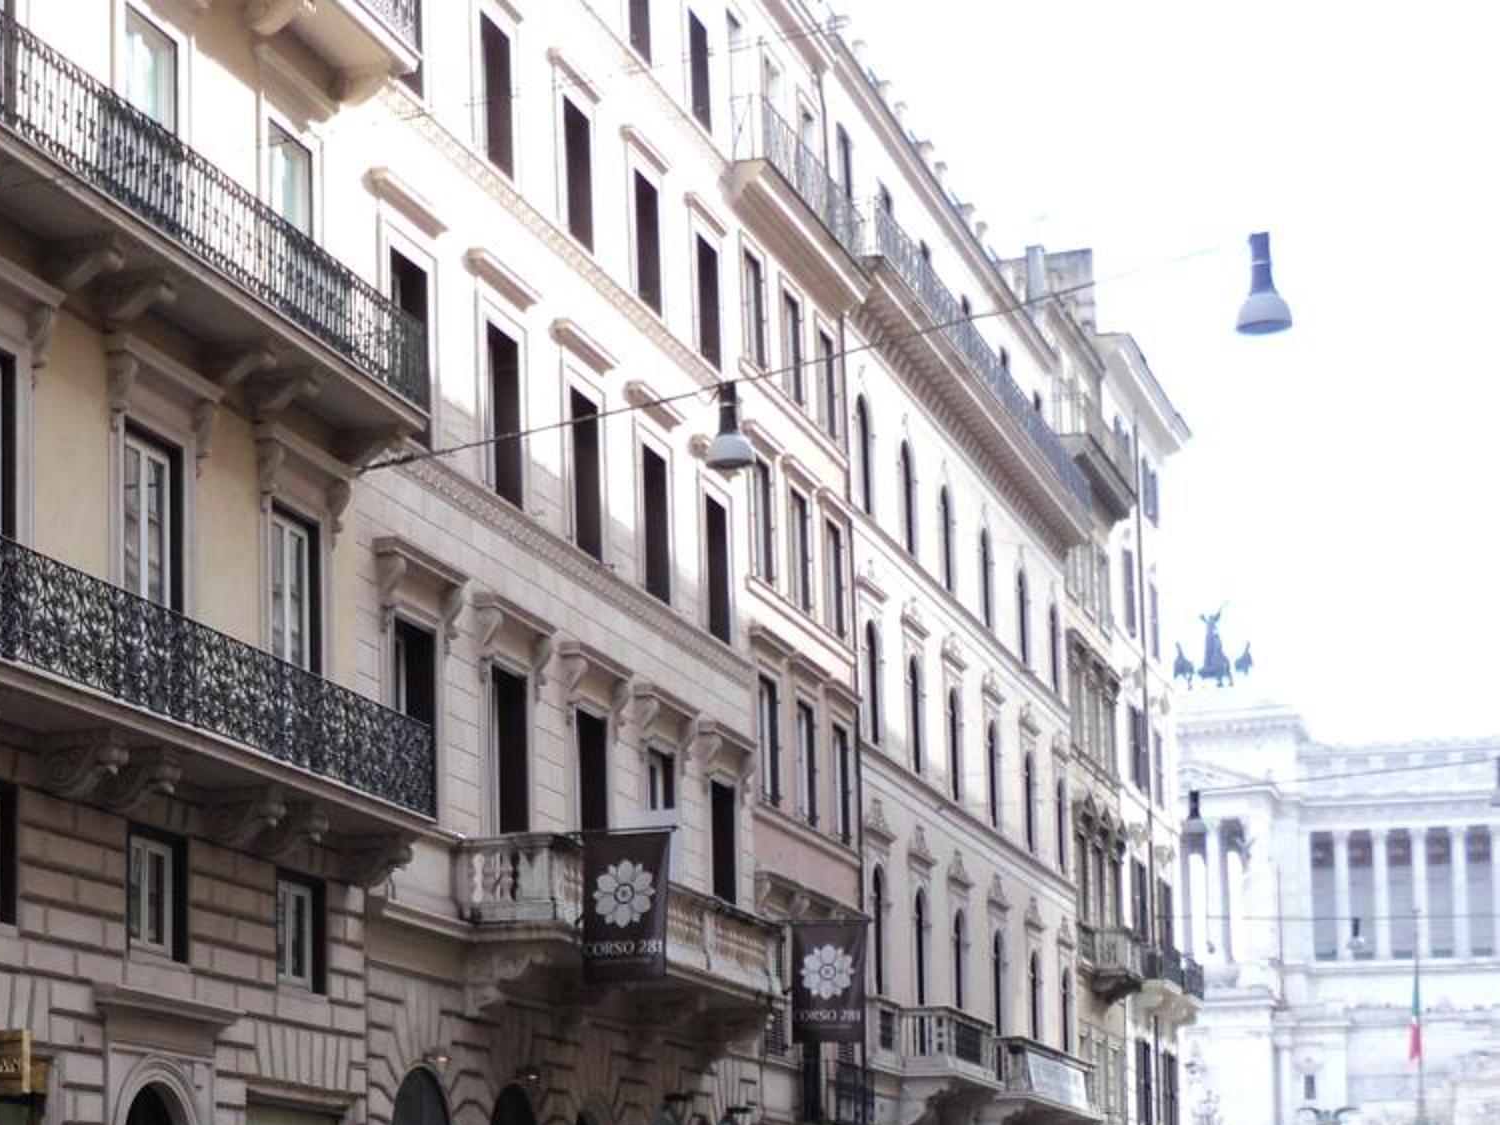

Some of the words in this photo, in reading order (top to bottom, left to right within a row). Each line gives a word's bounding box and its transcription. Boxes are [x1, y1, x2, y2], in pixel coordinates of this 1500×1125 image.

[584, 941, 635, 957] CORSO
[638, 939, 663, 954] 281
[793, 1008, 837, 1022] CORSO
